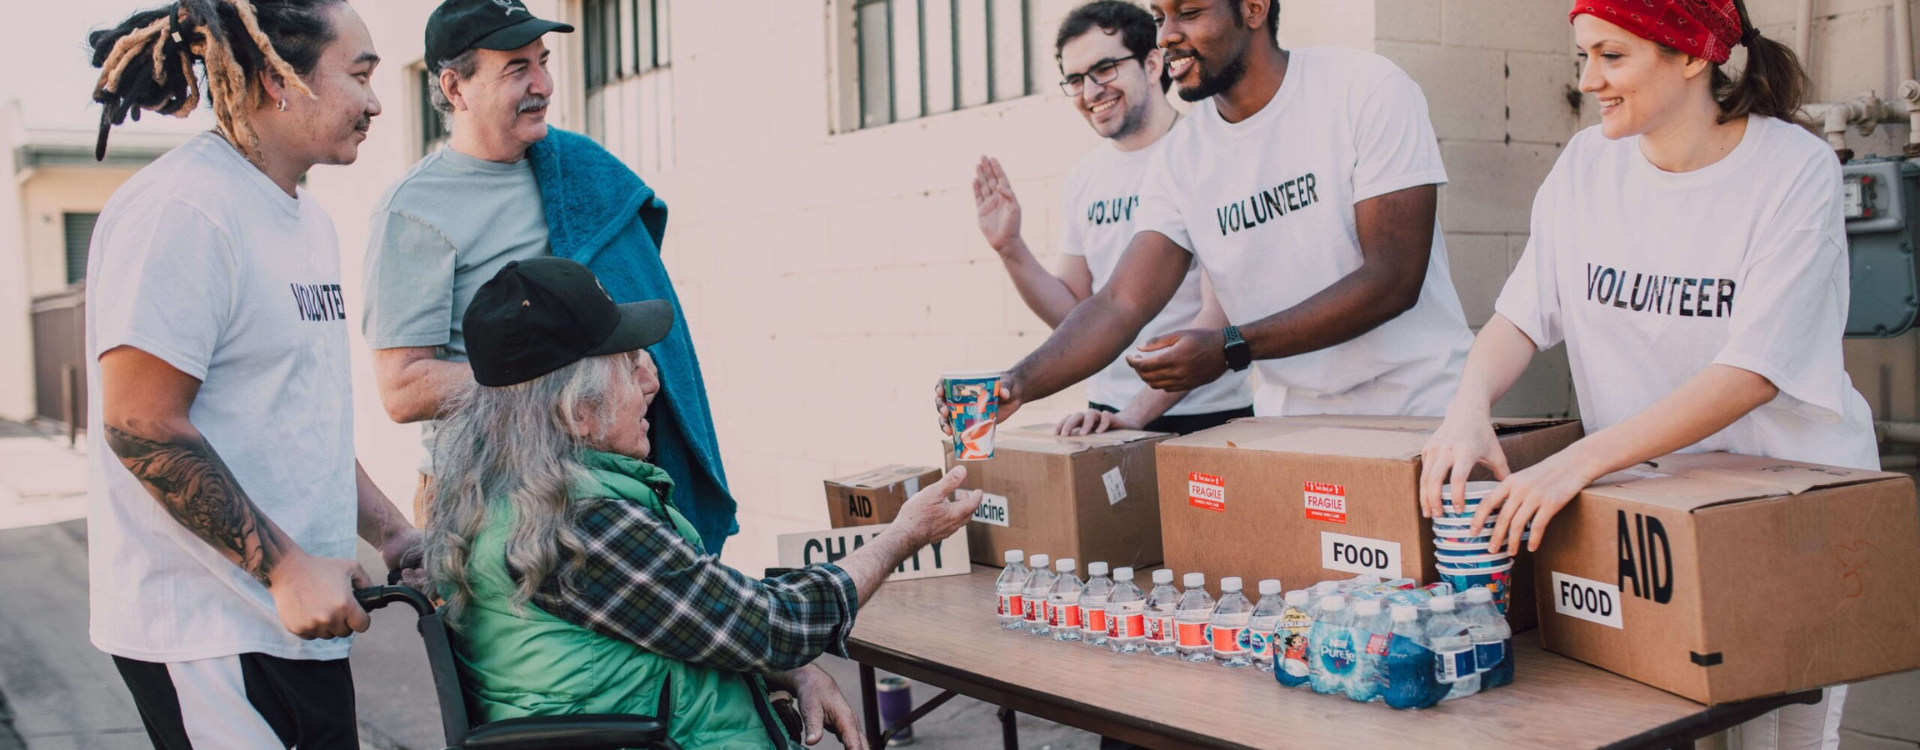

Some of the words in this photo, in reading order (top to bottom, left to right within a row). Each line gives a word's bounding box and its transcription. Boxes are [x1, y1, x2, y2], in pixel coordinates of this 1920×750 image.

[1217, 172, 1319, 236] VOLUNTEER
[290, 283, 346, 321] VOLUNTE
[1587, 263, 1736, 318] VOLUNTEER
[849, 494, 872, 518] AID
[1192, 485, 1222, 500] FRAGILE
[1308, 496, 1342, 510] FRAGILE
[1333, 542, 1389, 570] FOOD
[1617, 509, 1674, 605] AID
[1560, 580, 1612, 617] FOOD
